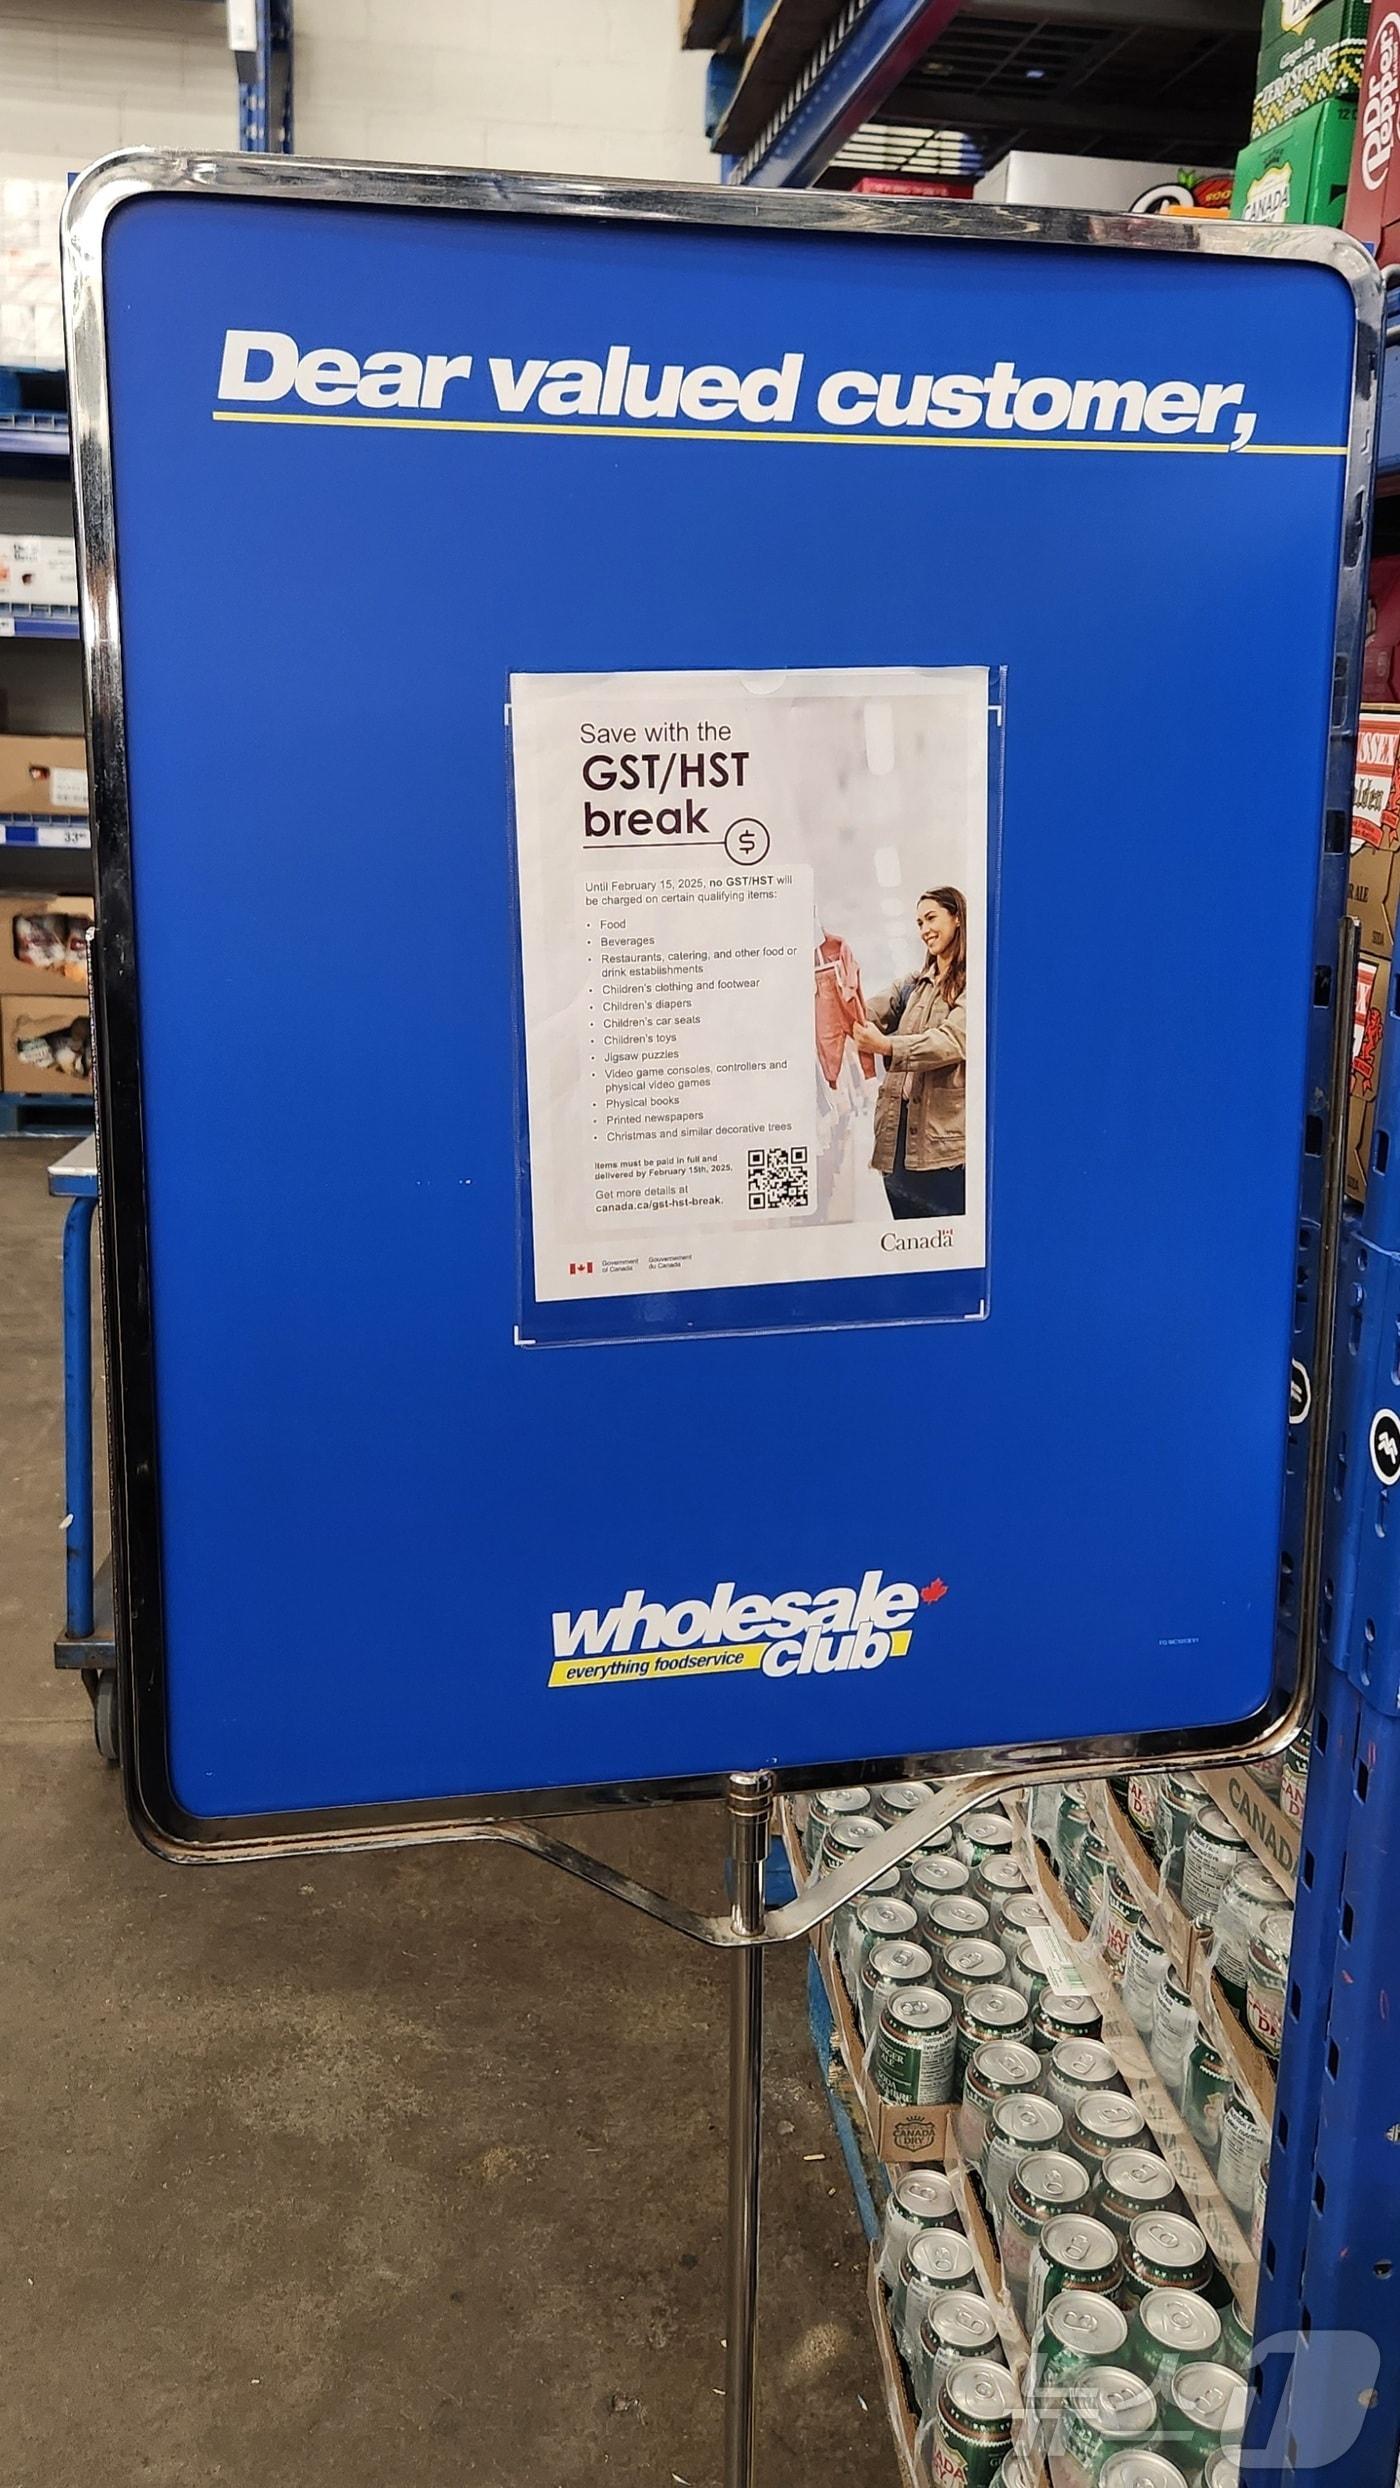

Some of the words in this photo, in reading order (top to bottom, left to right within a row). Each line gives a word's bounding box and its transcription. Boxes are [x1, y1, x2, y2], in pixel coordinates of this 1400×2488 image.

[217, 329, 473, 409] Dear
[488, 345, 804, 421] valued
[816, 361, 1257, 452] customer,
[580, 723, 637, 744] Save
[644, 721, 689, 743] with
[697, 721, 732, 742] the
[582, 751, 750, 795] GST/HST
[584, 798, 710, 838] break
[585, 881, 609, 893] Until
[611, 881, 657, 893] February
[660, 879, 675, 891] 15,
[678, 878, 707, 889] 2025,
[709, 879, 723, 888] no
[726, 875, 774, 887] GST/HST
[776, 875, 793, 885] will
[585, 896, 599, 906] be
[601, 894, 643, 907] charged
[645, 895, 659, 904] on
[661, 892, 695, 903] certain
[697, 890, 745, 904] qualifying
[747, 890, 777, 900] items:
[600, 919, 626, 930] Food
[601, 937, 655, 948] Beverages
[601, 953, 665, 965] Restaurants,
[667, 950, 711, 962] catering,
[713, 949, 733, 960] and
[734, 948, 761, 958] other
[762, 946, 784, 957] food
[786, 947, 798, 956] or
[601, 967, 627, 978] drink
[629, 964, 704, 977] establishments
[602, 983, 652, 995] Children's
[655, 981, 694, 993] clothing
[696, 980, 715, 991] and
[717, 979, 761, 990] footwear
[602, 1000, 653, 1012] Children's
[655, 999, 692, 1011] diapers
[603, 1016, 654, 1029] Children's
[655, 1017, 672, 1026] car
[674, 1015, 702, 1025] seats
[603, 1033, 654, 1046] Children's
[656, 1034, 677, 1045] toys
[604, 1052, 639, 1065] Jigsaw
[641, 1049, 680, 1063] puzzles
[604, 1068, 634, 1080] Video
[636, 1068, 665, 1080] game
[666, 1064, 713, 1076] consoles,
[716, 1061, 767, 1073] controllers
[769, 1059, 788, 1070] and
[605, 1080, 646, 1095] physical
[648, 1080, 676, 1090] video
[677, 1079, 711, 1091] games
[606, 1097, 648, 1111] Physical
[650, 1095, 680, 1107] books
[606, 1114, 642, 1126] Printed
[644, 1112, 704, 1124] newspapers
[607, 1131, 658, 1142] Christmas
[659, 1127, 678, 1139] and
[680, 1127, 713, 1137] similar
[715, 1123, 766, 1136] decorative
[768, 1123, 793, 1133] trees
[595, 1190, 614, 1200] Get
[616, 1189, 642, 1198] more
[644, 1185, 677, 1197] details
[678, 1185, 689, 1195] at
[595, 1195, 724, 1213] canada.ca/gst-hst-break.
[880, 1228, 954, 1252] Canada
[552, 1570, 920, 1657] wholesale
[762, 1620, 891, 1678] club
[566, 1657, 650, 1681] everything
[654, 1651, 744, 1673] foodservice
[893, 2129, 935, 2137] CANADA
[904, 2136, 924, 2145] DRY
